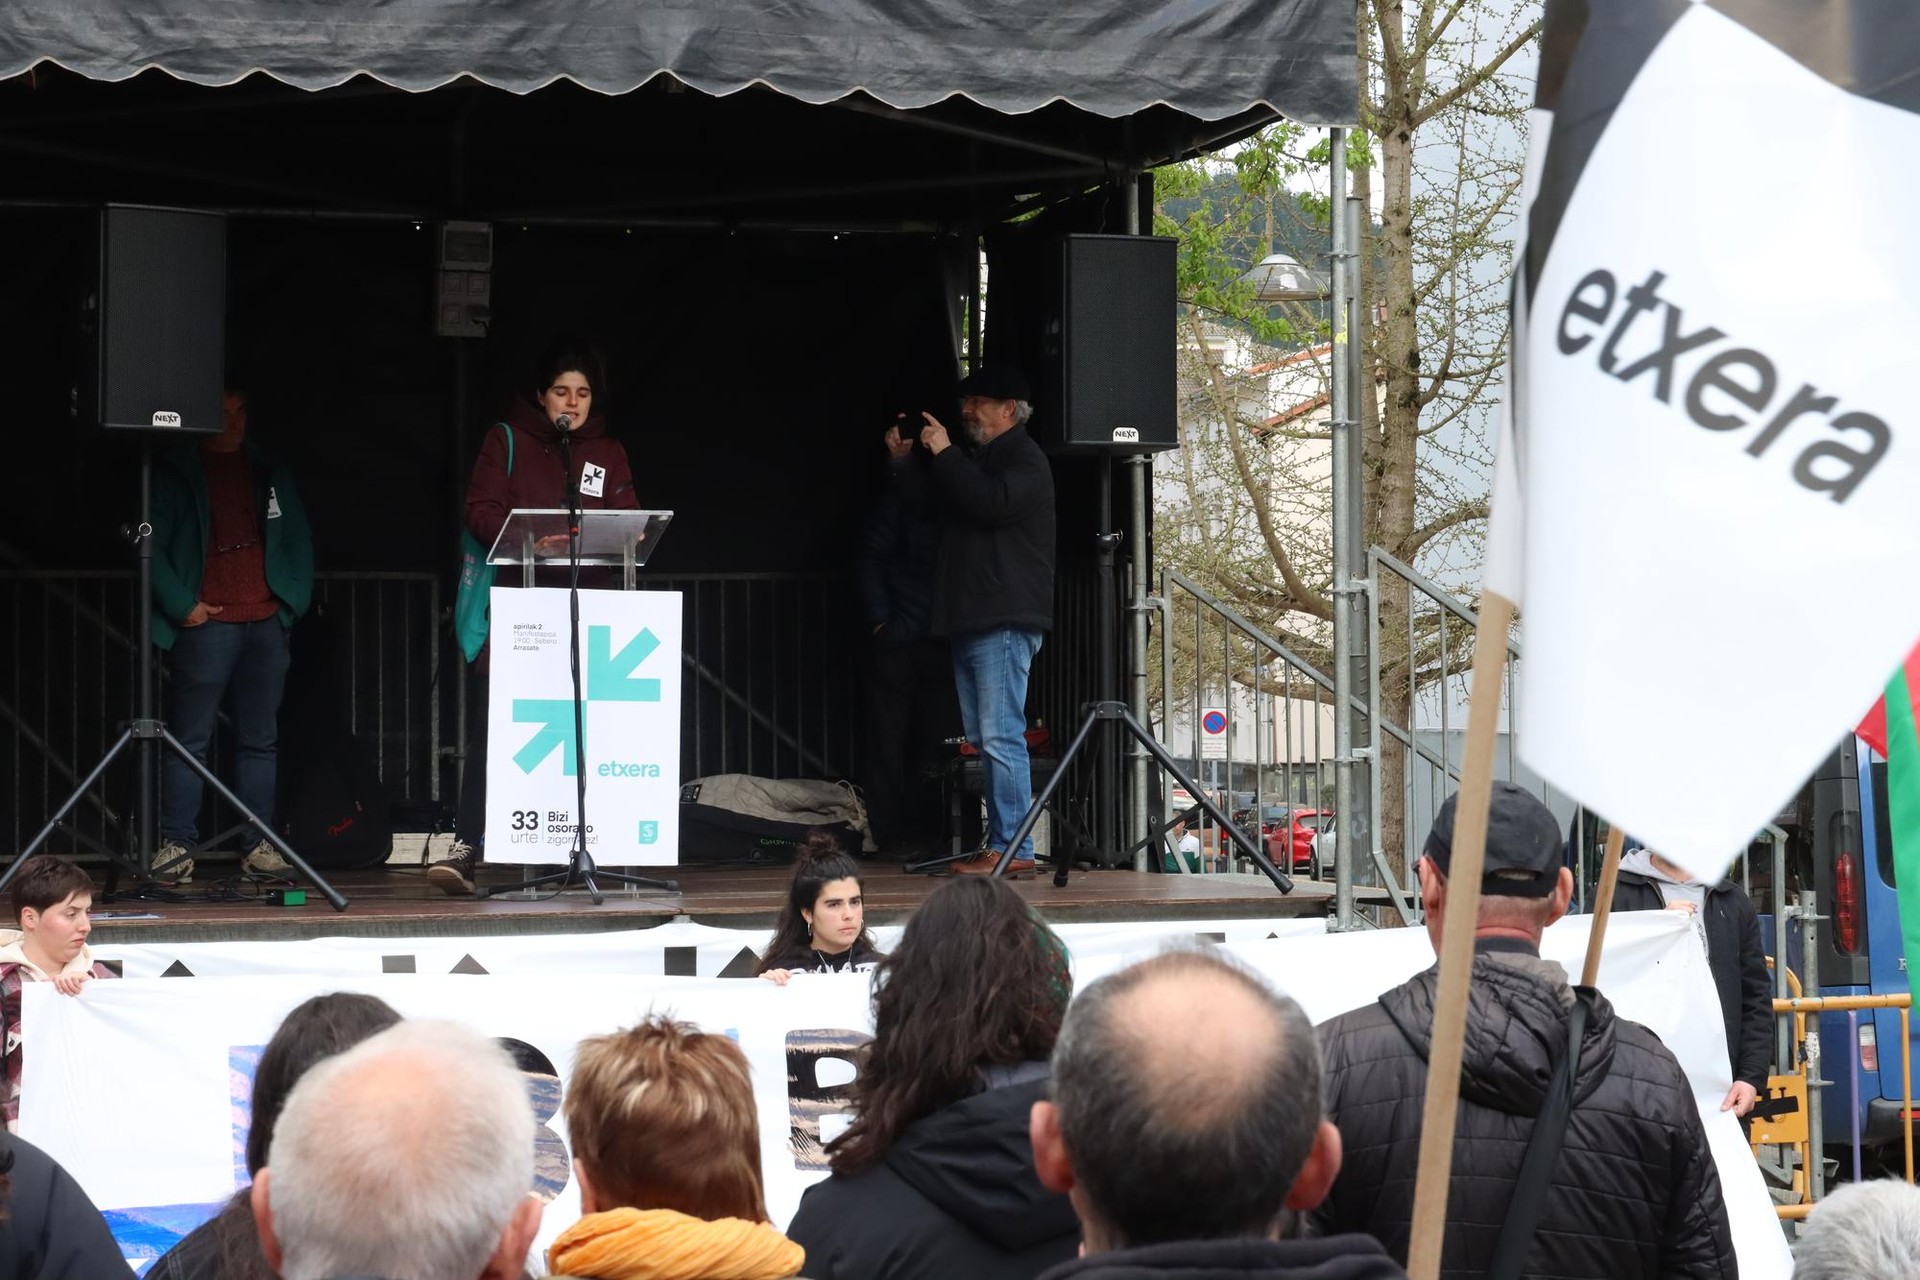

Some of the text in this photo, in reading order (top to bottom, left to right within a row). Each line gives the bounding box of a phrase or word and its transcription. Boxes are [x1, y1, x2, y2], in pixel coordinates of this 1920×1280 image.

[1556, 269, 1892, 505] etxera
[155, 414, 179, 423] NEXT
[1115, 430, 1137, 438] NEXT
[598, 761, 660, 777] etxera
[511, 810, 539, 831] 33
[548, 811, 569, 822] Bizi
[547, 824, 594, 833] osorao
[511, 832, 539, 844] urte
